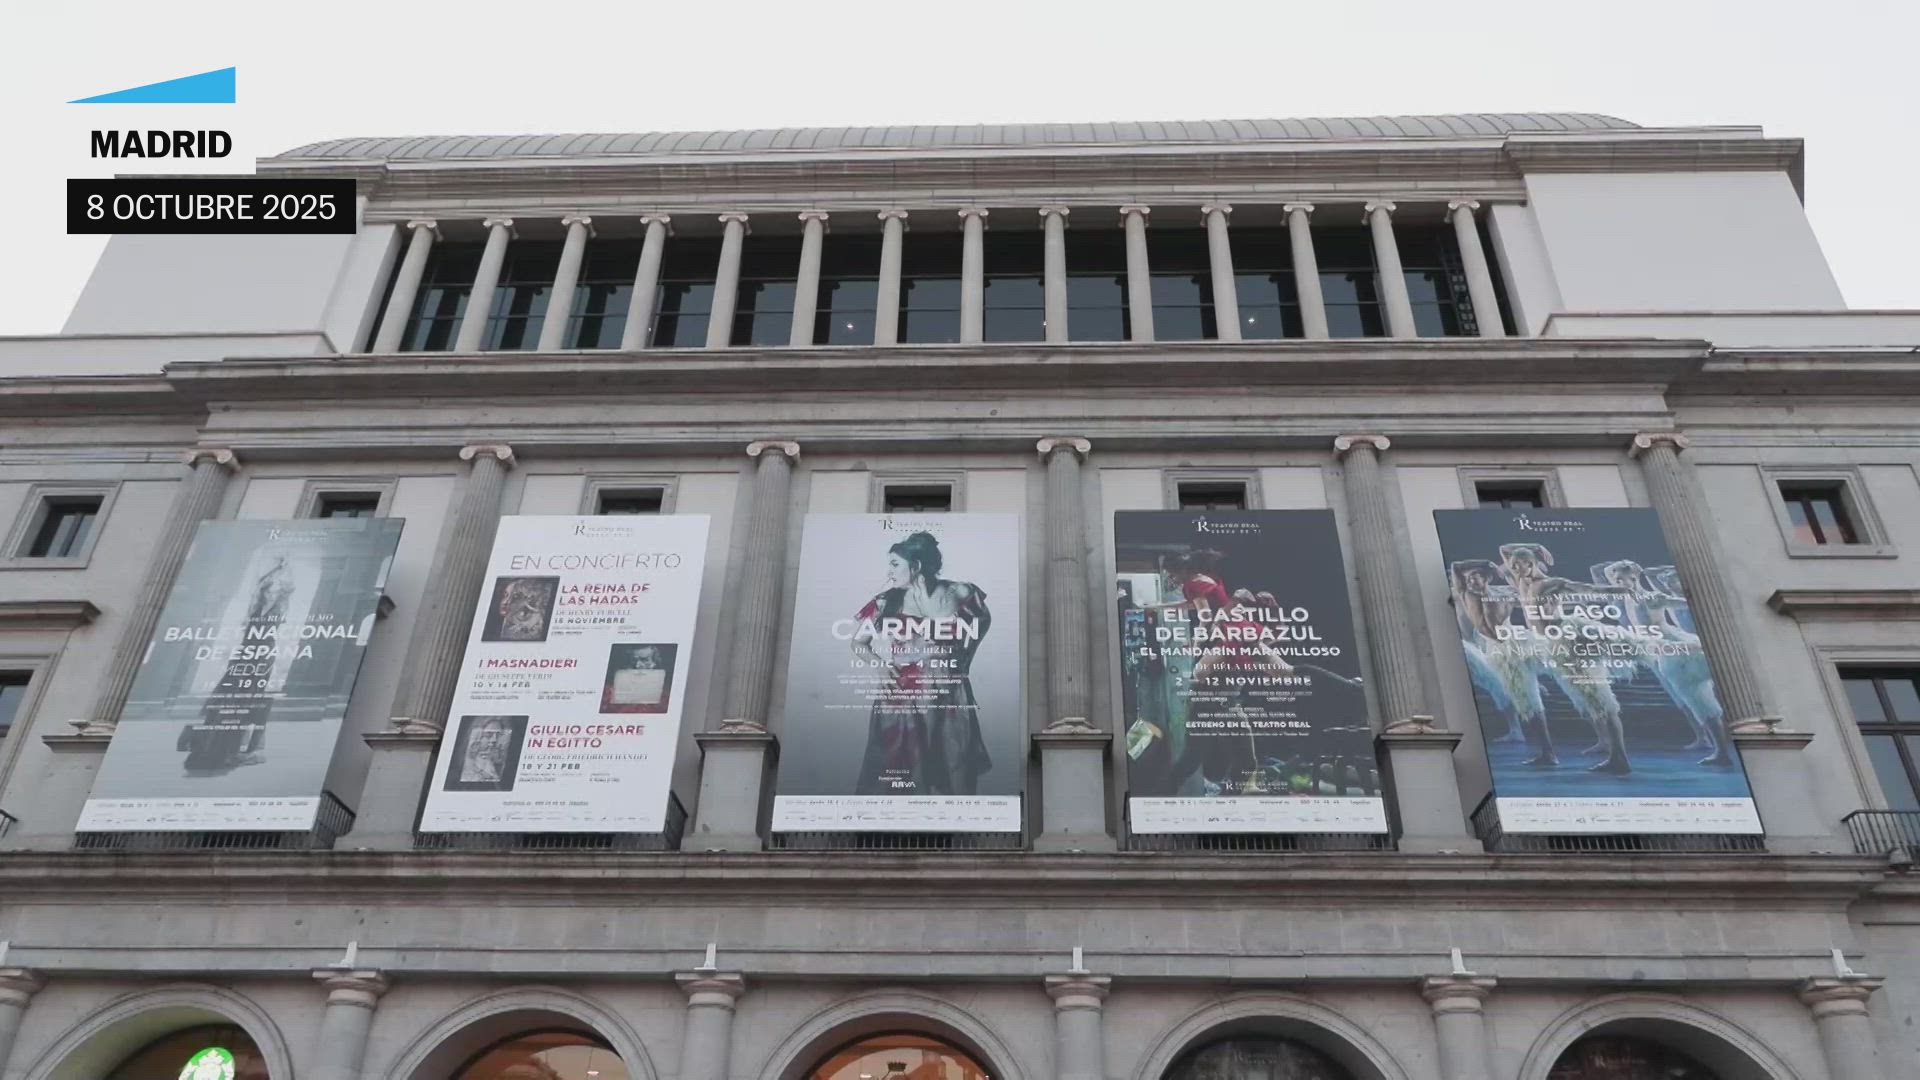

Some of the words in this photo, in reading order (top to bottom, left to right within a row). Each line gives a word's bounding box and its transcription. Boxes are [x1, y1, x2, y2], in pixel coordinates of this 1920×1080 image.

[510, 555, 542, 571] EN
[561, 585, 579, 594] LA
[584, 583, 626, 594] REINA
[558, 596, 586, 606] LAS
[589, 595, 639, 606] HADAS
[1163, 607, 1191, 623] EL
[1197, 606, 1309, 623] CASTILLO
[1525, 605, 1554, 620] EL
[1559, 605, 1622, 620] LAGO
[831, 616, 979, 642] CARMEN
[1155, 626, 1187, 641] DE
[1193, 626, 1322, 641] BARBAZUL
[1495, 625, 1528, 641] DE
[1533, 625, 1577, 641] LOS
[1582, 624, 1664, 641] CISNES
[1140, 647, 1157, 656] EL
[1160, 645, 1236, 656] MANDARÍN
[1240, 647, 1341, 656] MARAVILLOSO
[487, 659, 578, 668] MASNADIERI
[850, 659, 865, 668] 10
[870, 659, 894, 668] DIC
[930, 659, 958, 668] ENE
[1580, 659, 1598, 668] 22
[1602, 659, 1634, 669] NOV
[1175, 677, 1183, 687] 2
[1205, 677, 1220, 687] 12
[1225, 676, 1313, 687] NOVIEMBRE
[530, 725, 582, 736] GIULIO
[585, 725, 646, 736] CESARE
[527, 738, 544, 748] IN
[547, 737, 603, 749] EGITTO
